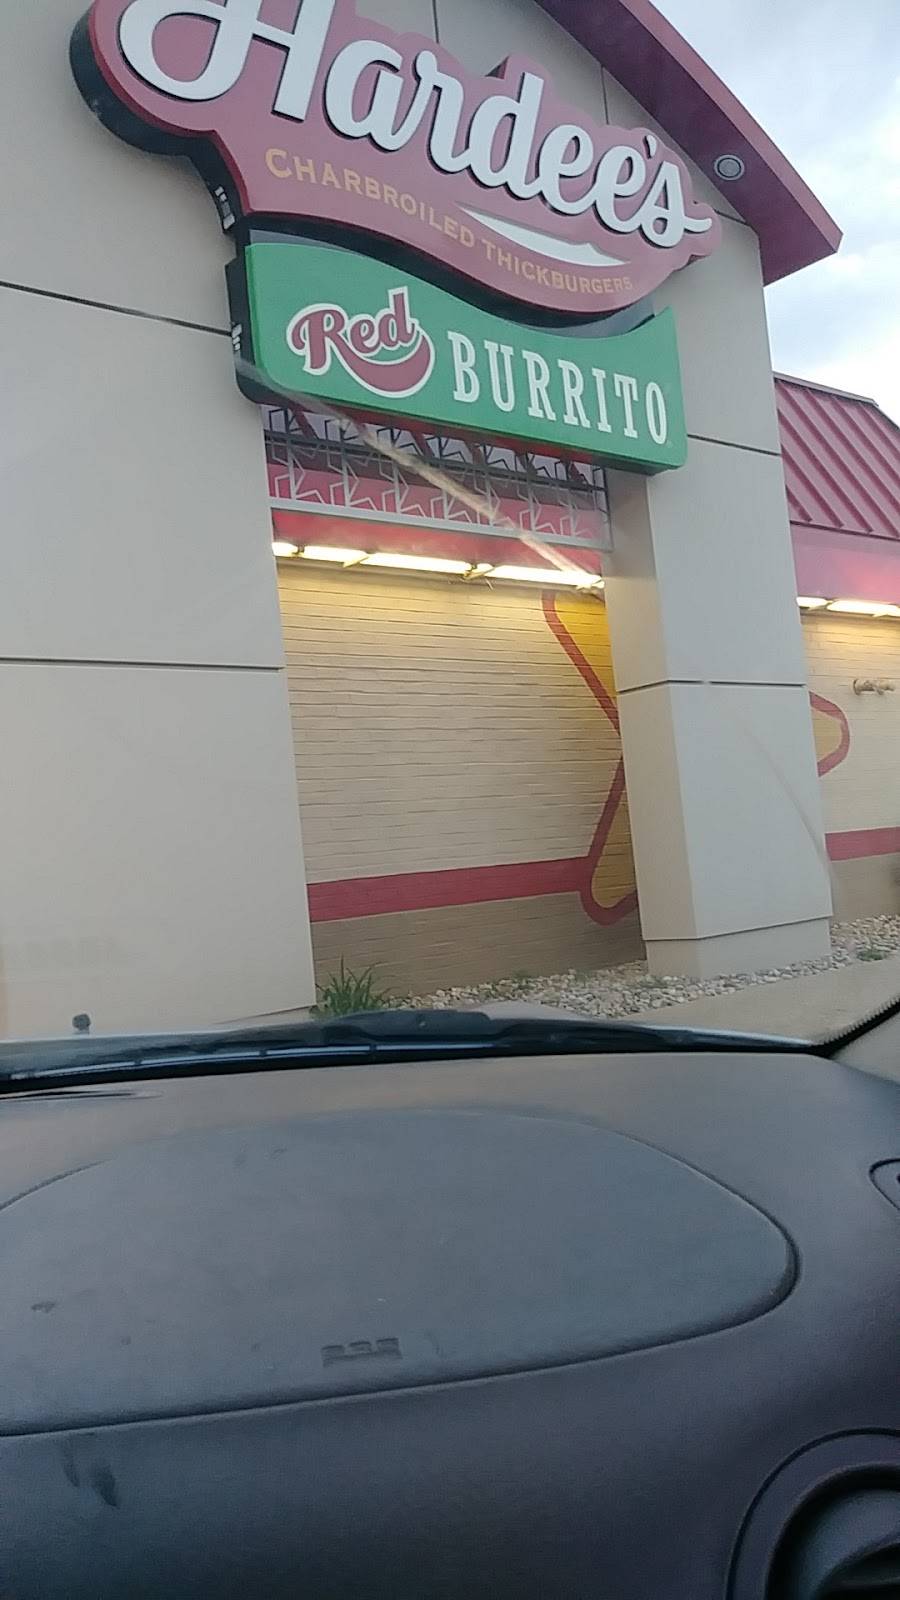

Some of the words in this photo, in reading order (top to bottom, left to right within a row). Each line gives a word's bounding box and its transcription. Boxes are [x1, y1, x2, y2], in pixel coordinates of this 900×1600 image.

[118, 0, 712, 248] Hardee's
[265, 148, 475, 248] CHARBROILED
[483, 240, 633, 293] THICKBURGERS
[286, 286, 435, 397] Red
[448, 331, 667, 445] BURRITO
